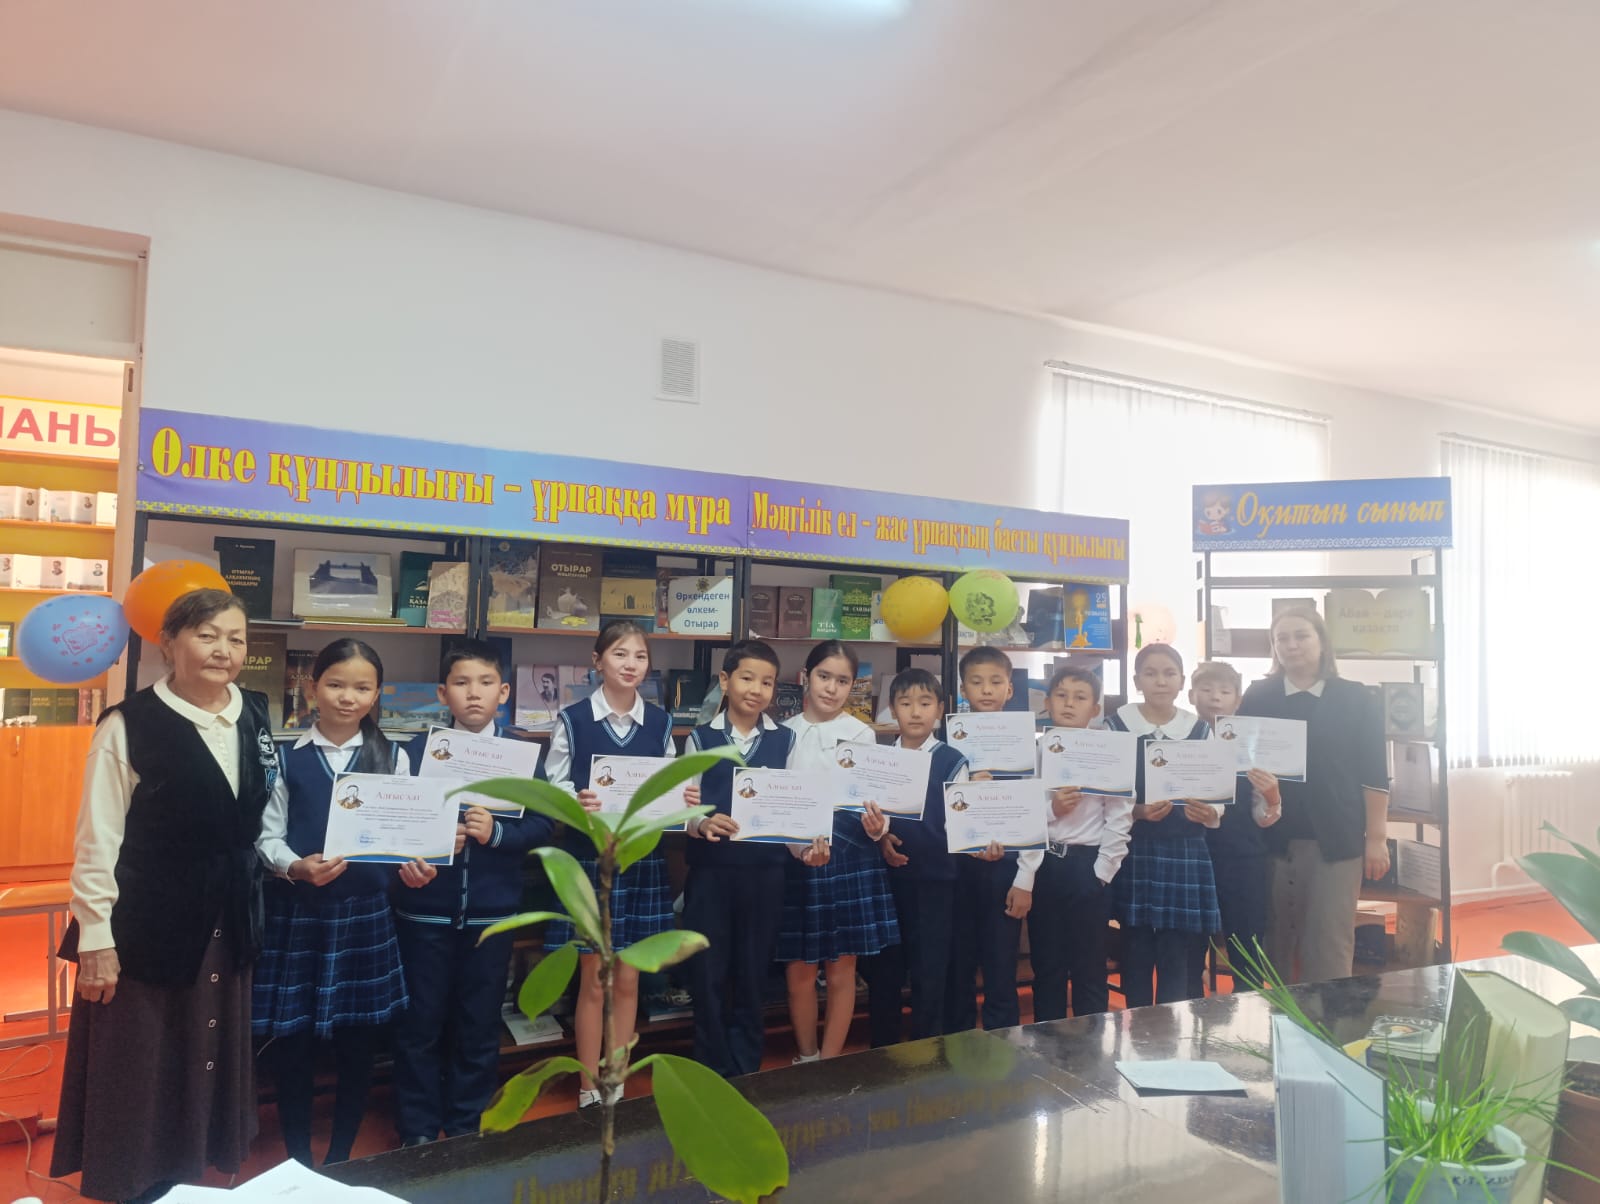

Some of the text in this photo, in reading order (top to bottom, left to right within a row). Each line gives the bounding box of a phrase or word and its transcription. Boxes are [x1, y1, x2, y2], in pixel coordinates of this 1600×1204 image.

[152, 426, 256, 483] Өлке
[268, 452, 494, 505] құндылығы
[531, 479, 657, 526] ұрпаққа
[665, 492, 731, 535] мұра
[1236, 492, 1447, 538] Оқитын сынып
[752, 491, 833, 541] Мәңгілік
[837, 509, 857, 539] ел
[875, 515, 909, 543] жас
[994, 518, 1040, 555] басты
[551, 563, 592, 573] ОТЫРАР
[675, 592, 730, 602] Өркендеген
[687, 607, 718, 615] өлкем-
[684, 619, 719, 630] Отырар
